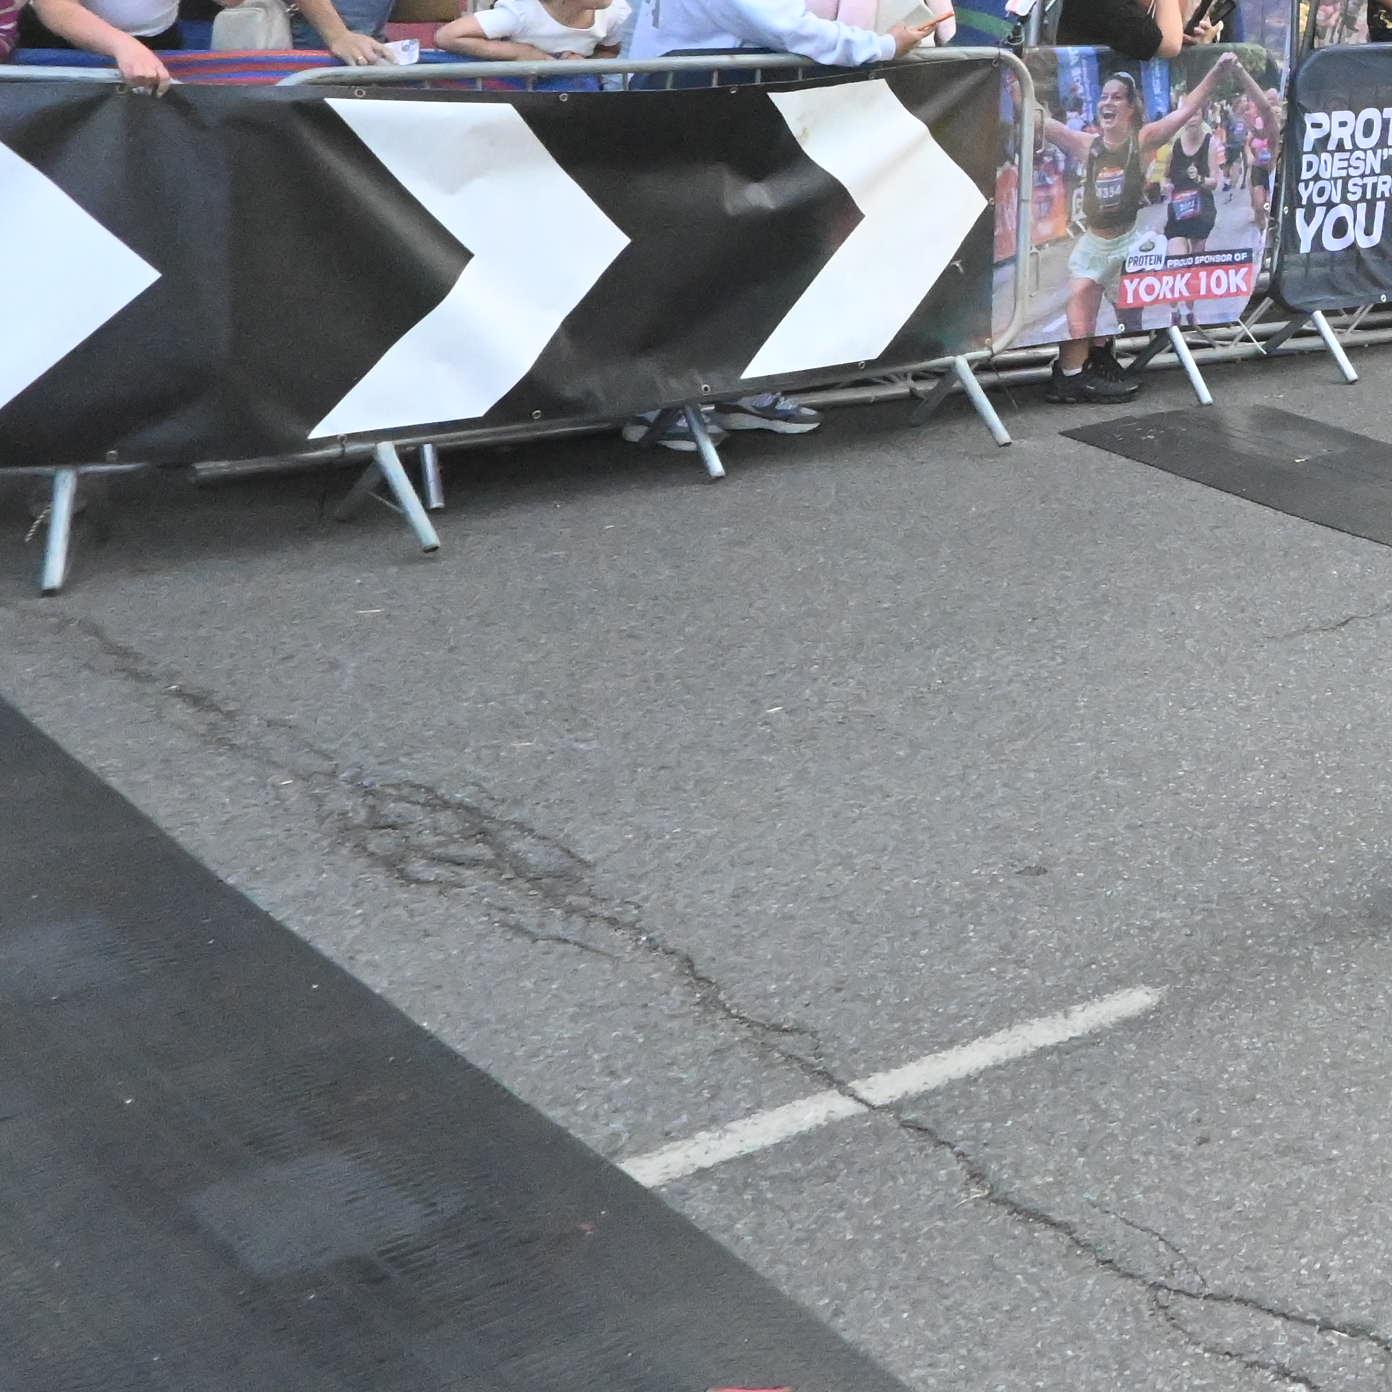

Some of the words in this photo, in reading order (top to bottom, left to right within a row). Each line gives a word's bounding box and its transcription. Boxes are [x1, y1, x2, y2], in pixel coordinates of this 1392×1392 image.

[1298, 179, 1343, 205] YOU
[1295, 201, 1386, 254] YOU
[1127, 254, 1163, 268] PROTEIN
[1167, 257, 1194, 269] PROUD
[1194, 254, 1233, 266] SPONSOR
[1234, 251, 1248, 262] OF
[1123, 272, 1193, 305] YORK
[1199, 267, 1249, 296] 10K
